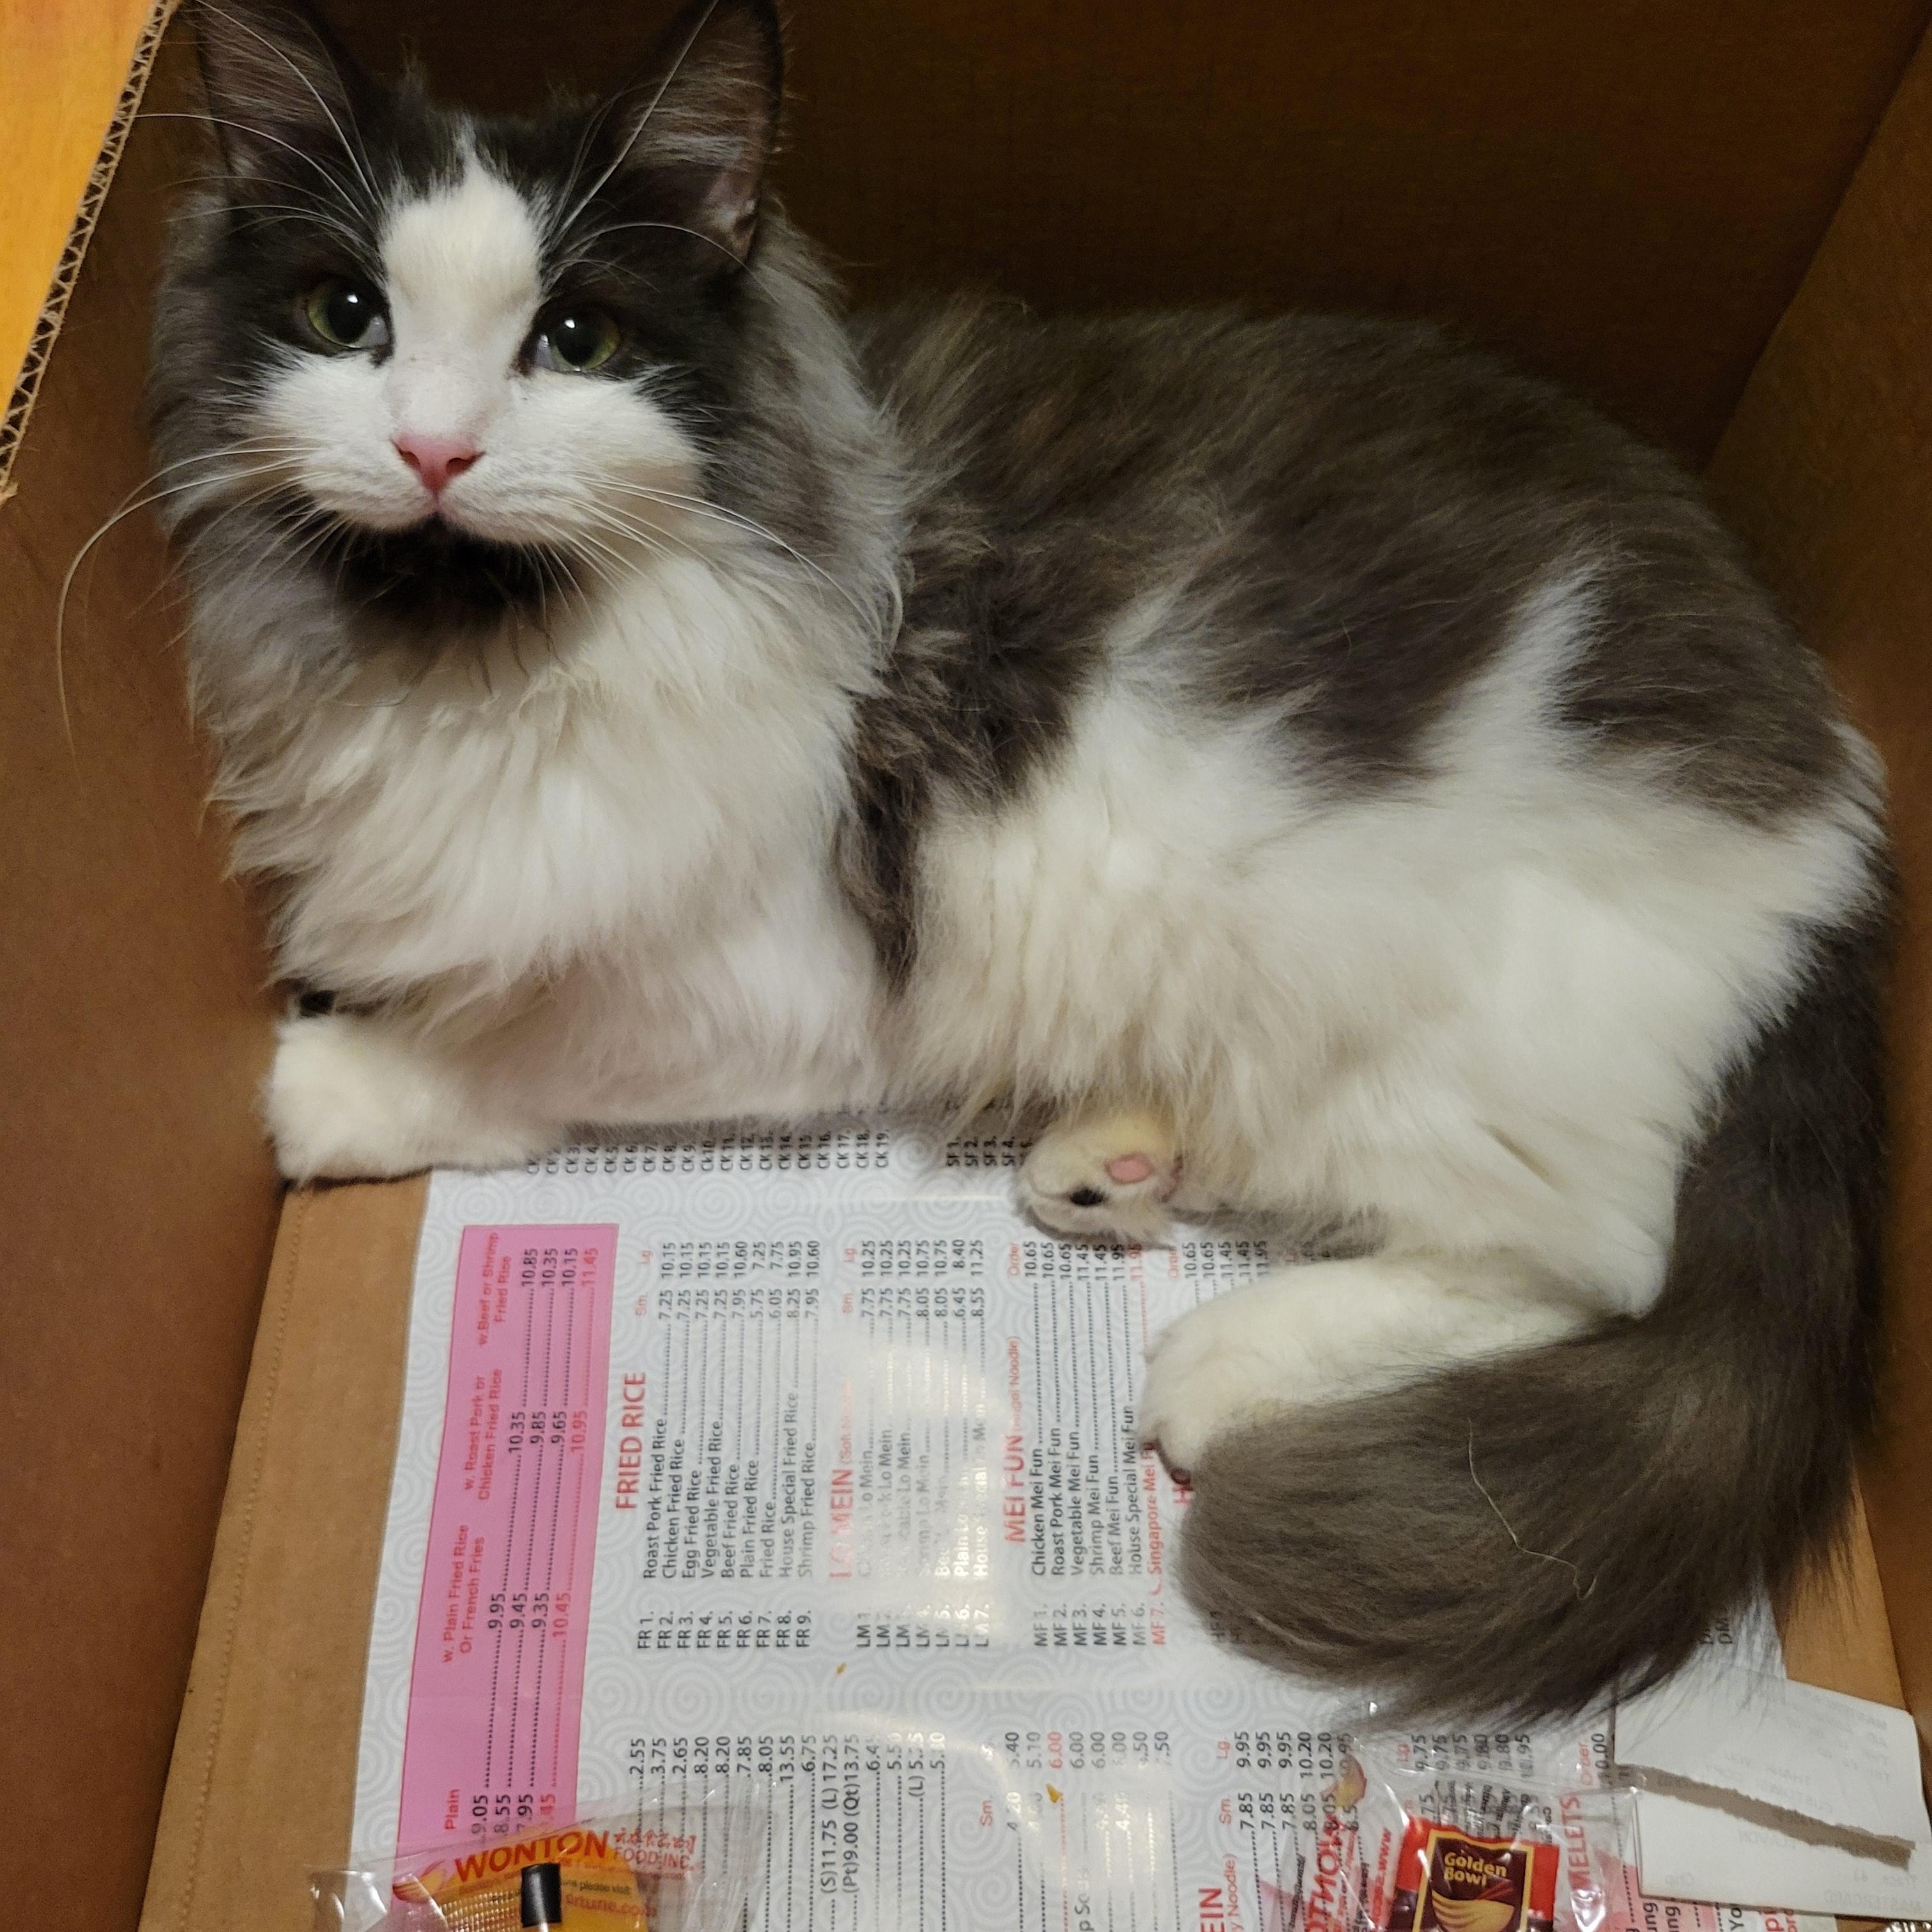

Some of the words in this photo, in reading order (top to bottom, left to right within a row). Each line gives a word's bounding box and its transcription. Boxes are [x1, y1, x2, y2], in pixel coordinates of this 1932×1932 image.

[837, 1153, 850, 1169] CK
[856, 1152, 870, 1169] CK
[875, 1151, 889, 1169] CK
[482, 1232, 500, 1278] Shrimp
[497, 1256, 511, 1283] Rice
[661, 1243, 675, 1278] 10.15
[680, 1243, 693, 1278] 10.15
[734, 1241, 748, 1278] 10.60
[753, 1241, 766, 1270] 7.25
[788, 1241, 802, 1277] 10.95
[862, 1240, 876, 1277] 10.25
[880, 1240, 893, 1277] 10.25
[917, 1239, 930, 1276] 10.75
[970, 1239, 984, 1276] 11.25
[1008, 1242, 1020, 1276] Order
[1024, 1241, 1038, 1277] 10.65
[1183, 1242, 1197, 1279] 10.65
[481, 1282, 491, 1294] or
[493, 1288, 508, 1322] Fried
[659, 1290, 671, 1319] 7.25
[678, 1290, 691, 1319] 7.25
[733, 1289, 746, 1319] 7.95
[751, 1289, 764, 1319] 5.75
[786, 1289, 801, 1318] 8.25
[861, 1288, 875, 1317] 7.75
[880, 1288, 893, 1317] 7.75
[916, 1288, 929, 1317] 8.05
[475, 1376, 485, 1390] or
[487, 1369, 502, 1399] Rice
[622, 1372, 646, 1428] RICE
[469, 1393, 483, 1426] Pork
[484, 1404, 500, 1439] Fried
[785, 1393, 799, 1423] Rice
[465, 1430, 481, 1471] Roast
[488, 1593, 506, 1630] 9.95
[508, 1411, 526, 1453] 10.35
[522, 1248, 538, 1287] 10.85
[510, 1593, 527, 1630] 9.45
[530, 1411, 546, 1444] 9.85
[541, 1248, 558, 1287] 10.35
[532, 1593, 549, 1629] 9.35
[551, 1411, 567, 1444] 9.65
[562, 1248, 578, 1287] 10.15
[553, 1592, 571, 1639] 10.45
[570, 1411, 588, 1453] 10.95
[582, 1248, 599, 1287] 11.45
[652, 1418, 666, 1449] Rice
[709, 1421, 723, 1452] Rice
[783, 1428, 797, 1465] Fried
[878, 1429, 893, 1466] Mein
[898, 1432, 911, 1469] Mein
[1048, 1428, 1062, 1456] Fun
[1066, 1431, 1080, 1459] Fun
[478, 1443, 495, 1500] Chicken
[670, 1439, 685, 1469] Rice
[803, 1443, 816, 1473] Rice
[859, 1450, 874, 1488] Mein
[1004, 1436, 1024, 1487] FUN
[1030, 1448, 1043, 1476] Fun
[464, 1475, 476, 1490] w.
[615, 1436, 643, 1510] FRIED
[648, 1454, 665, 1492] Fried
[687, 1470, 702, 1501] Rice
[706, 1457, 721, 1494] Fried
[727, 1464, 740, 1496] Rice
[746, 1460, 760, 1491] Rice
[1048, 1460, 1062, 1488] Mei
[1067, 1464, 1081, 1492] Mei
[668, 1475, 684, 1512] Fried
[781, 1470, 798, 1524] Special
[801, 1478, 816, 1516] Fried
[831, 1469, 854, 1535] MEIN
[1030, 1481, 1044, 1509] Mei
[1048, 1492, 1064, 1528] Pork
[646, 1496, 661, 1531] Pork
[684, 1505, 700, 1545] Fried
[723, 1499, 738, 1539] Fried
[742, 1496, 758, 1535] Fried
[762, 1502, 776, 1533] Rice
[1004, 1496, 1026, 1542] MEI
[453, 1526, 469, 1556] Rice
[662, 1517, 680, 1579] Chicken
[702, 1499, 720, 1578] Vegetable
[779, 1529, 795, 1577] House
[798, 1521, 817, 1577] Shrimp
[1031, 1514, 1047, 1576] Chicken
[1068, 1496, 1084, 1576] Vegetable
[1144, 1496, 1165, 1575] Singapore
[467, 1536, 485, 1573] Fries
[643, 1535, 659, 1578] Roast
[682, 1550, 701, 1578] Egg
[721, 1544, 736, 1578] Beef
[740, 1539, 756, 1578] Plain
[760, 1538, 775, 1577] Fried
[1050, 1532, 1066, 1576] Roast
[448, 1561, 464, 1599] Fried
[461, 1577, 480, 1630] French
[443, 1604, 459, 1641] Plain
[638, 1629, 652, 1648] FR
[657, 1629, 671, 1648] FR
[717, 1629, 732, 1648] FR
[796, 1629, 810, 1648] FR
[1053, 1622, 1068, 1646] MF
[1093, 1622, 1107, 1646] MF
[441, 1647, 454, 1662] w.
[460, 1635, 473, 1653] Or
[630, 1738, 645, 1775] 2.55
[652, 1738, 666, 1774] 3.75
[695, 1737, 710, 1773] 8.20
[780, 1735, 795, 1782] 13.55
[822, 1735, 838, 1781] 17.25
[1048, 1731, 1062, 1769] 6.00
[1070, 1731, 1084, 1768] 6.00
[1235, 1731, 1250, 1768] 9.95
[1257, 1731, 1271, 1768] 9.95
[1298, 1732, 1314, 1779] 10.20
[444, 1789, 460, 1830] Plain
[820, 1788, 838, 1809] (L)
[1239, 1793, 1255, 1829] 7.85
[454, 1828, 610, 1883] WONTON
[613, 1846, 658, 1865] FOOD
[1443, 1851, 1508, 1877] Golden
[1224, 1853, 1241, 1917] Noodle)
[1443, 1867, 1488, 1887] Bowl
